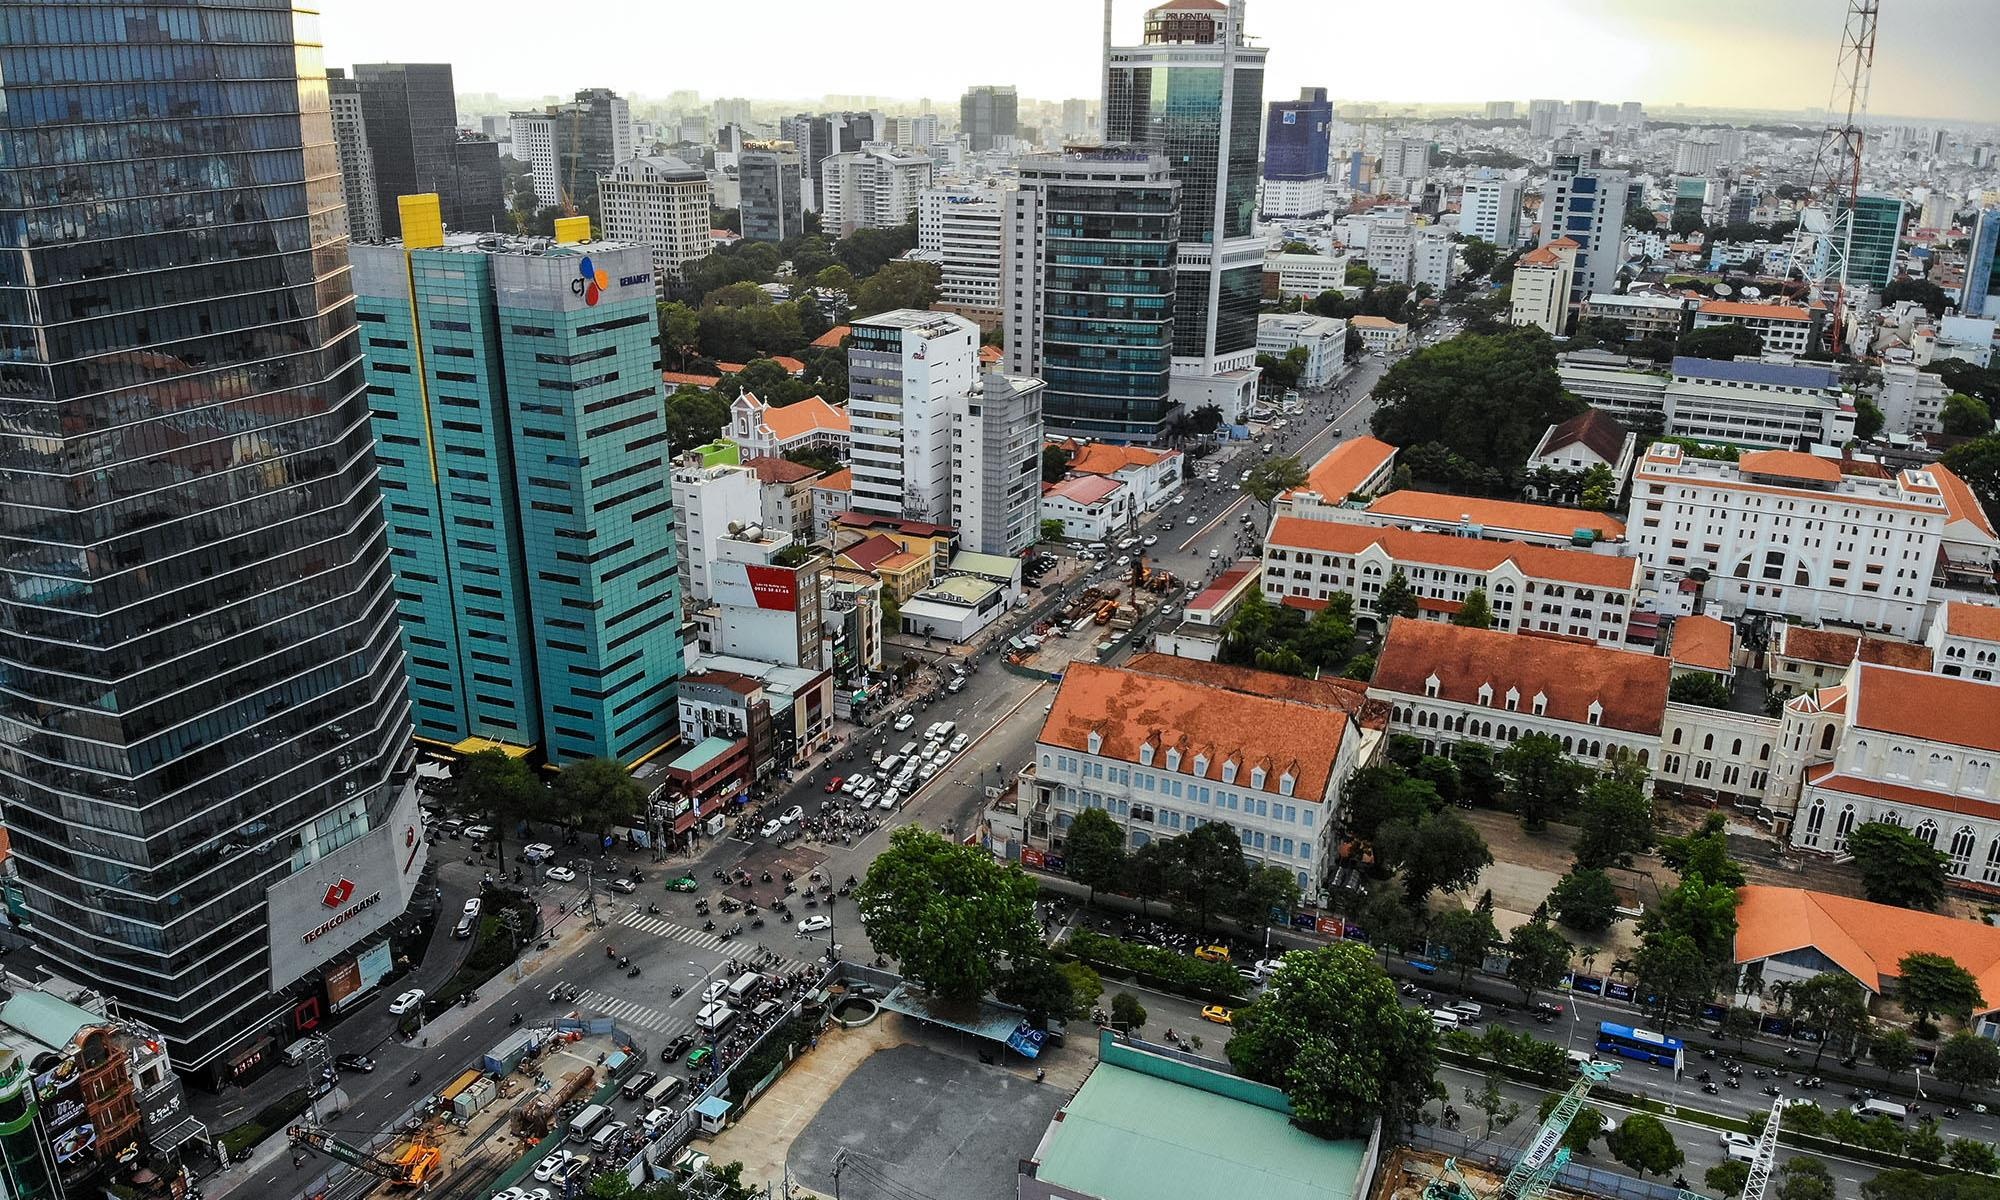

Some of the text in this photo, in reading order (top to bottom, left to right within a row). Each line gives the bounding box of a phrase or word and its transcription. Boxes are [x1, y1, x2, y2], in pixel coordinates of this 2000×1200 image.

[1165, 12, 1212, 20] PRUDENTIAL
[742, 142, 769, 150] HDBank
[302, 890, 381, 944] TECHCOMBANK
